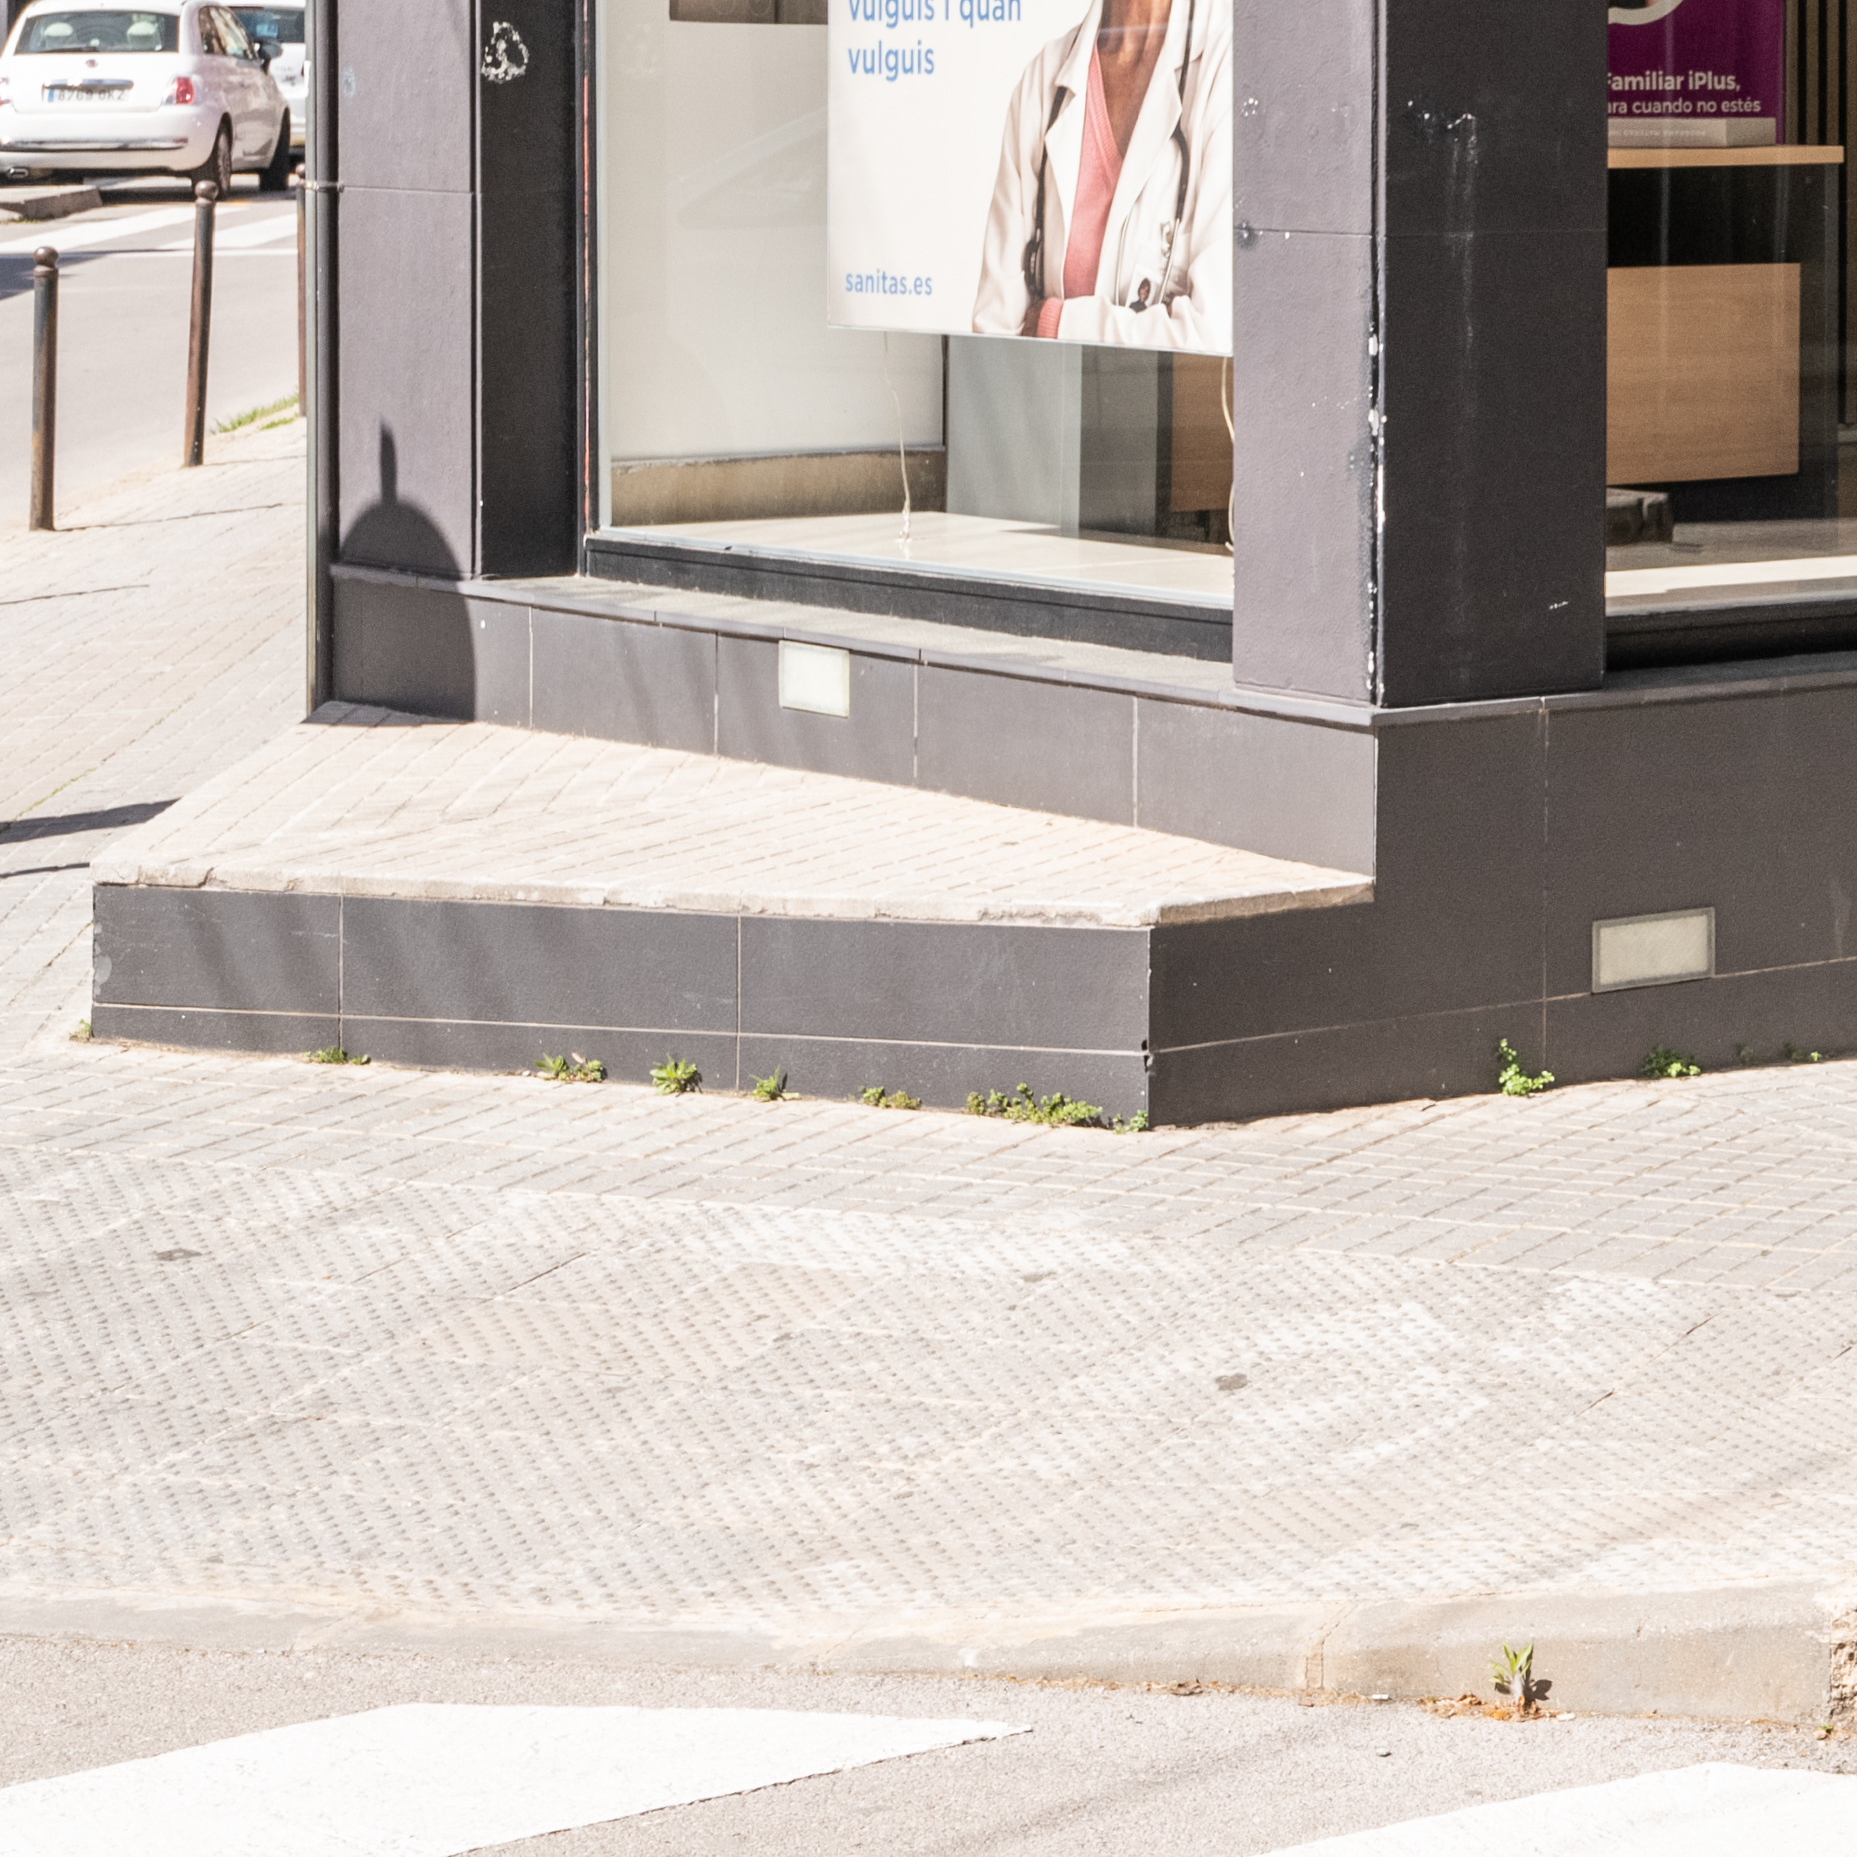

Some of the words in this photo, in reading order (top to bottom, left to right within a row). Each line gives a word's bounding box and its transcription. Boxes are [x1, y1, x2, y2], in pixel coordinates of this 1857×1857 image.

[848, 42, 935, 82] vulguis
[1688, 70, 1740, 91] iPlus,
[1632, 98, 1692, 113] cuando
[1697, 101, 1717, 113] no
[1721, 97, 1761, 113] estés
[845, 271, 932, 297] sanitas.es
